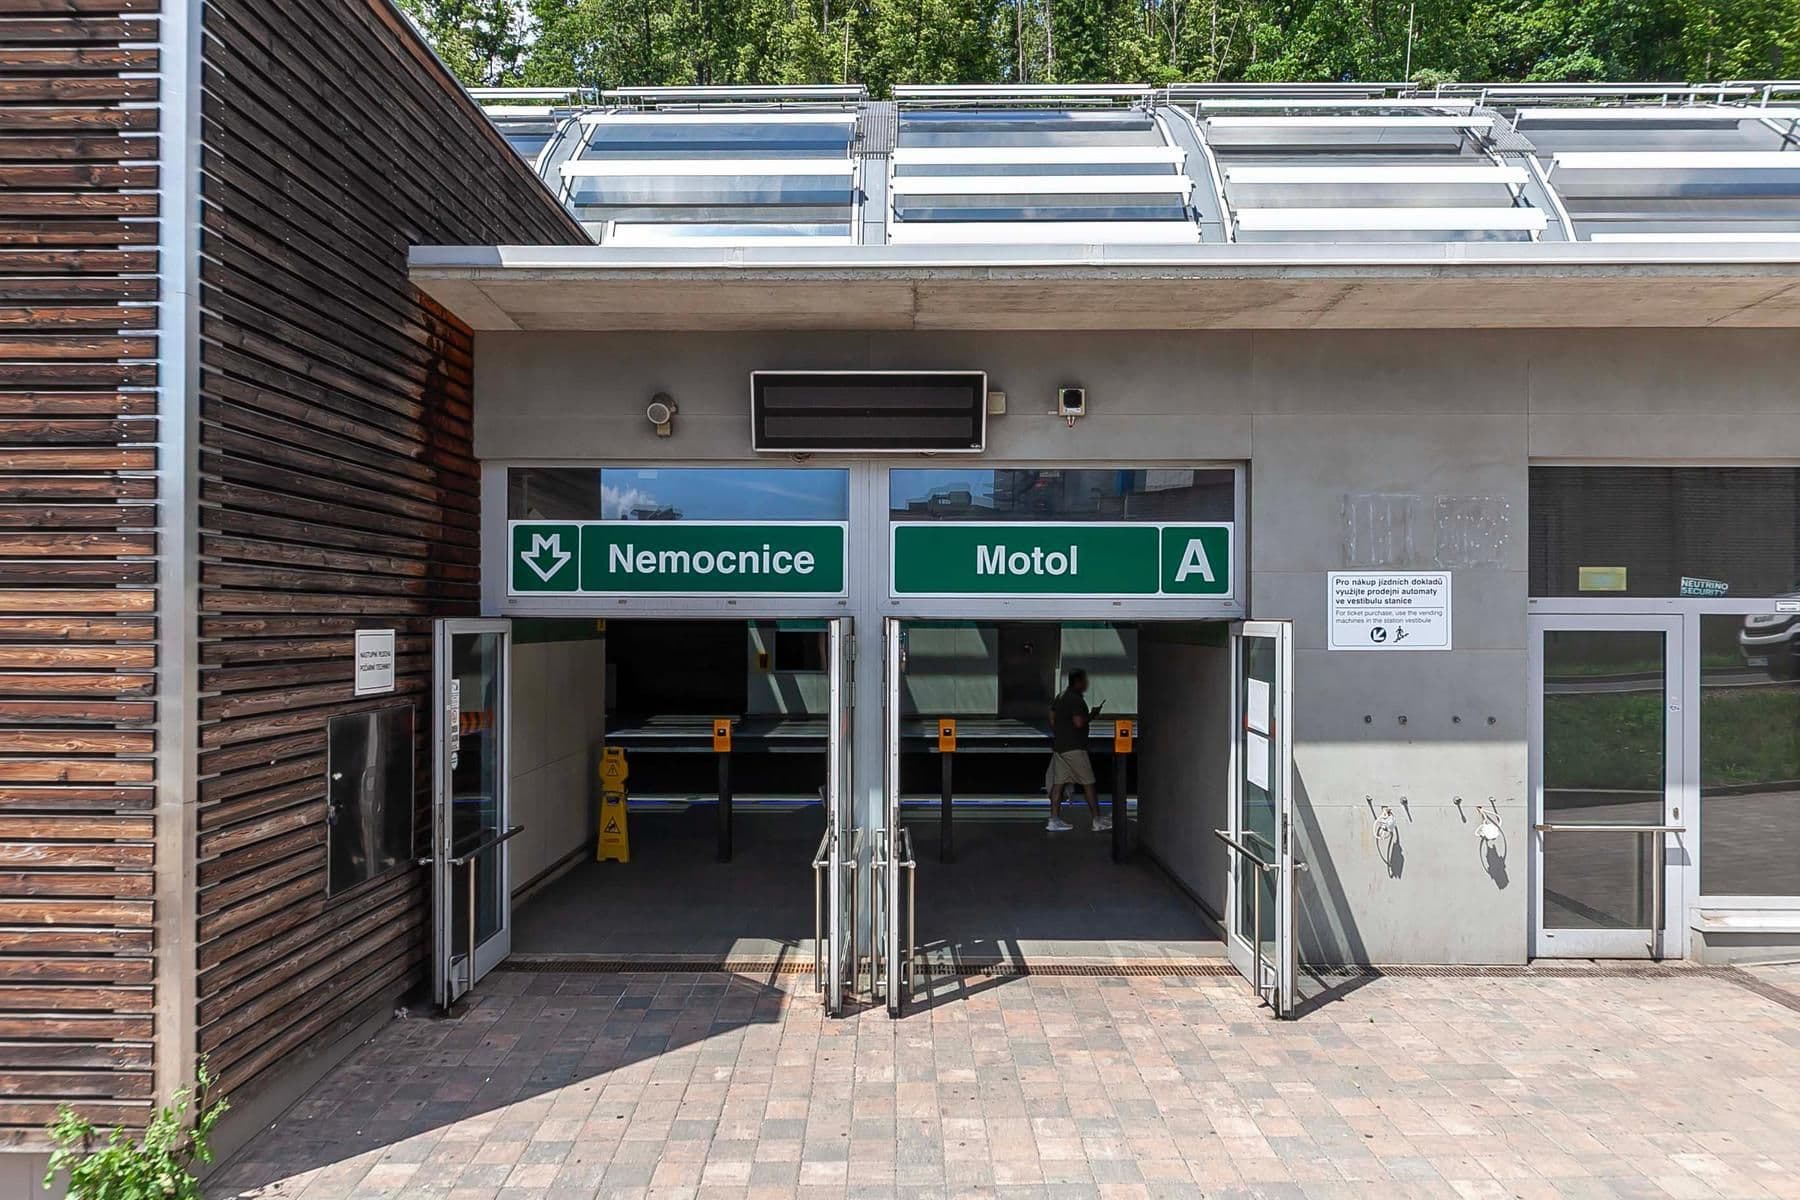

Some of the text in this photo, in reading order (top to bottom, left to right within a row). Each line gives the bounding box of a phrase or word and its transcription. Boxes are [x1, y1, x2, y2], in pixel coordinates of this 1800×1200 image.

[608, 544, 1078, 575] Nemocnice Motol
[1174, 538, 1216, 583] A
[1335, 577, 1443, 587] Pro nákup jízdních dokladů
[1681, 579, 1729, 591] NEUTRINO
[1335, 588, 1438, 596] využijte prodejní automaty
[1681, 587, 1727, 595] SECURITY
[1347, 597, 1383, 605] vestibulu
[1384, 597, 1413, 605] stanice
[1418, 610, 1443, 618] vending
